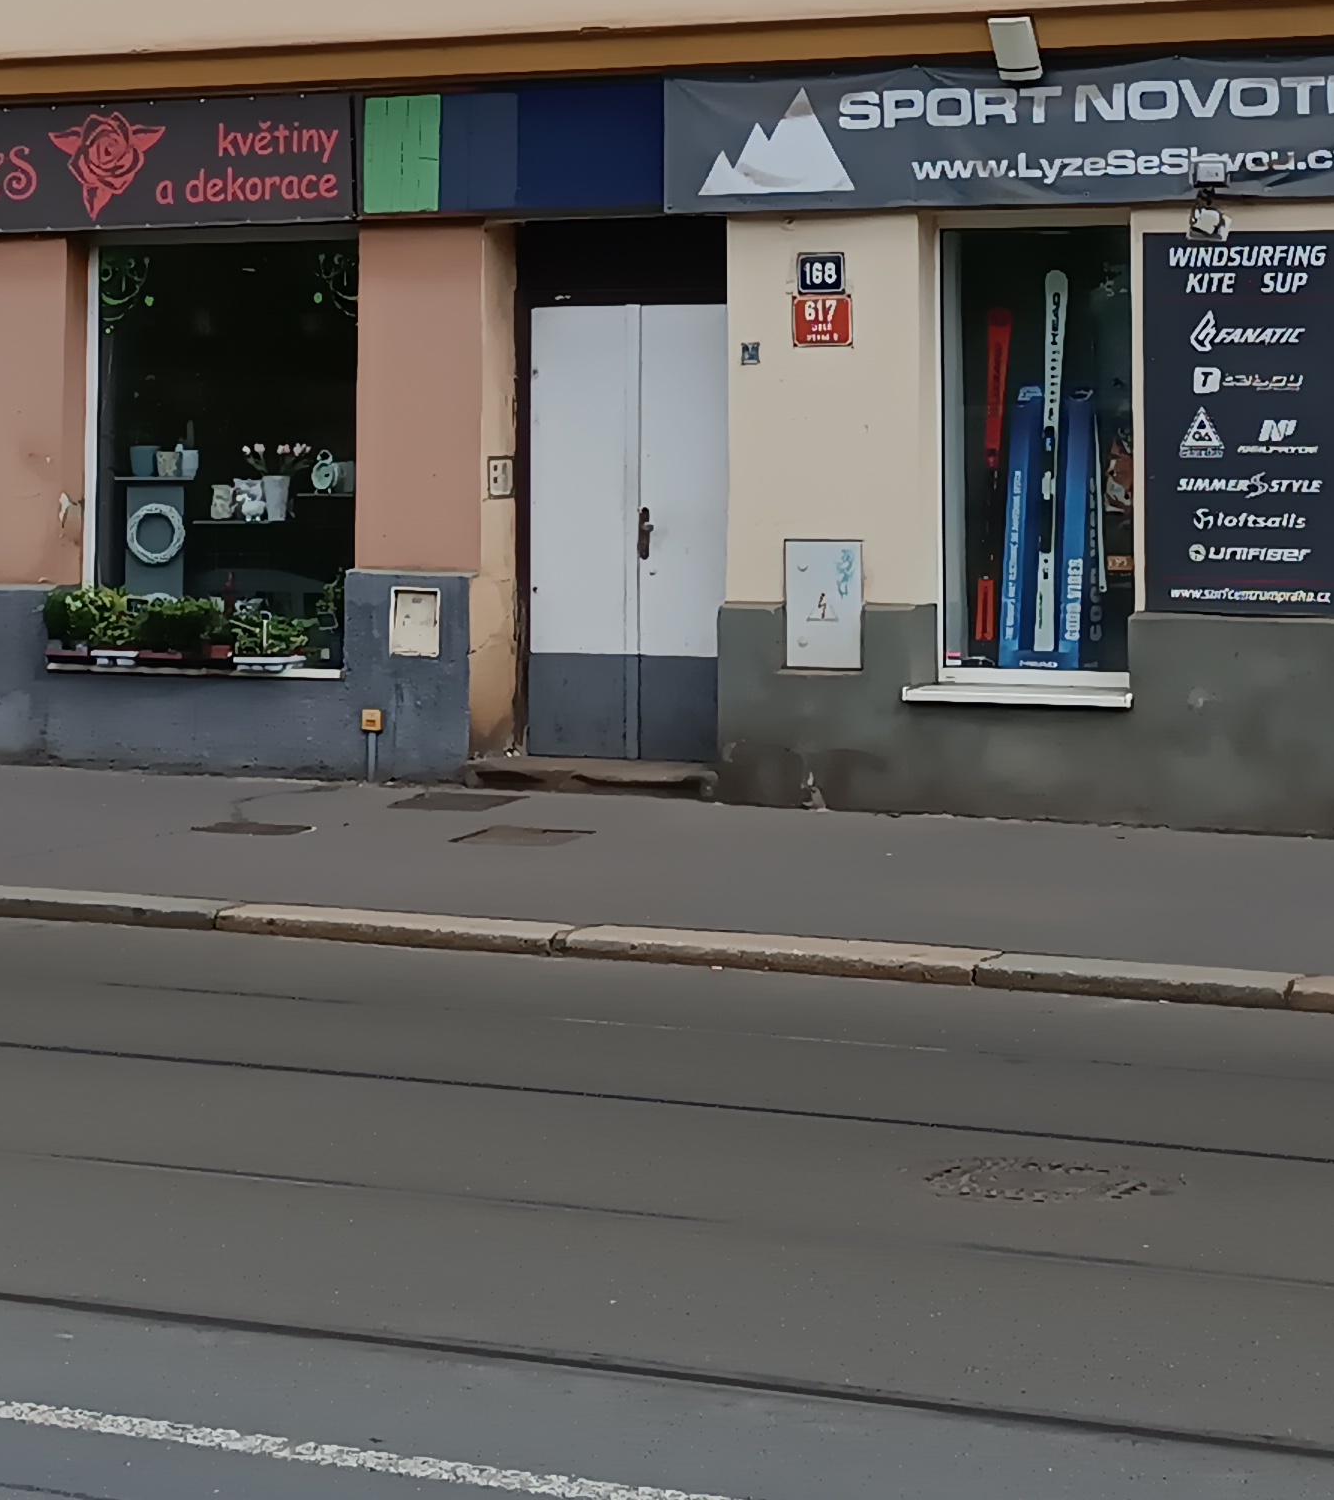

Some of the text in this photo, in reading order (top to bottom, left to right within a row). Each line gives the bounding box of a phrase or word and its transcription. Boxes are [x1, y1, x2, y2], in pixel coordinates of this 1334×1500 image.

[838, 85, 1063, 131] SPORT
[218, 120, 338, 163] květiny
[156, 169, 338, 204] a dekorace
[1169, 245, 1327, 267] WINDSURFING
[803, 262, 837, 285] 168
[1186, 272, 1308, 293] KITE SUP
[805, 299, 837, 321] 617
[1214, 327, 1306, 344] FANATIC
[1177, 478, 1323, 493] SIMMER STYLE
